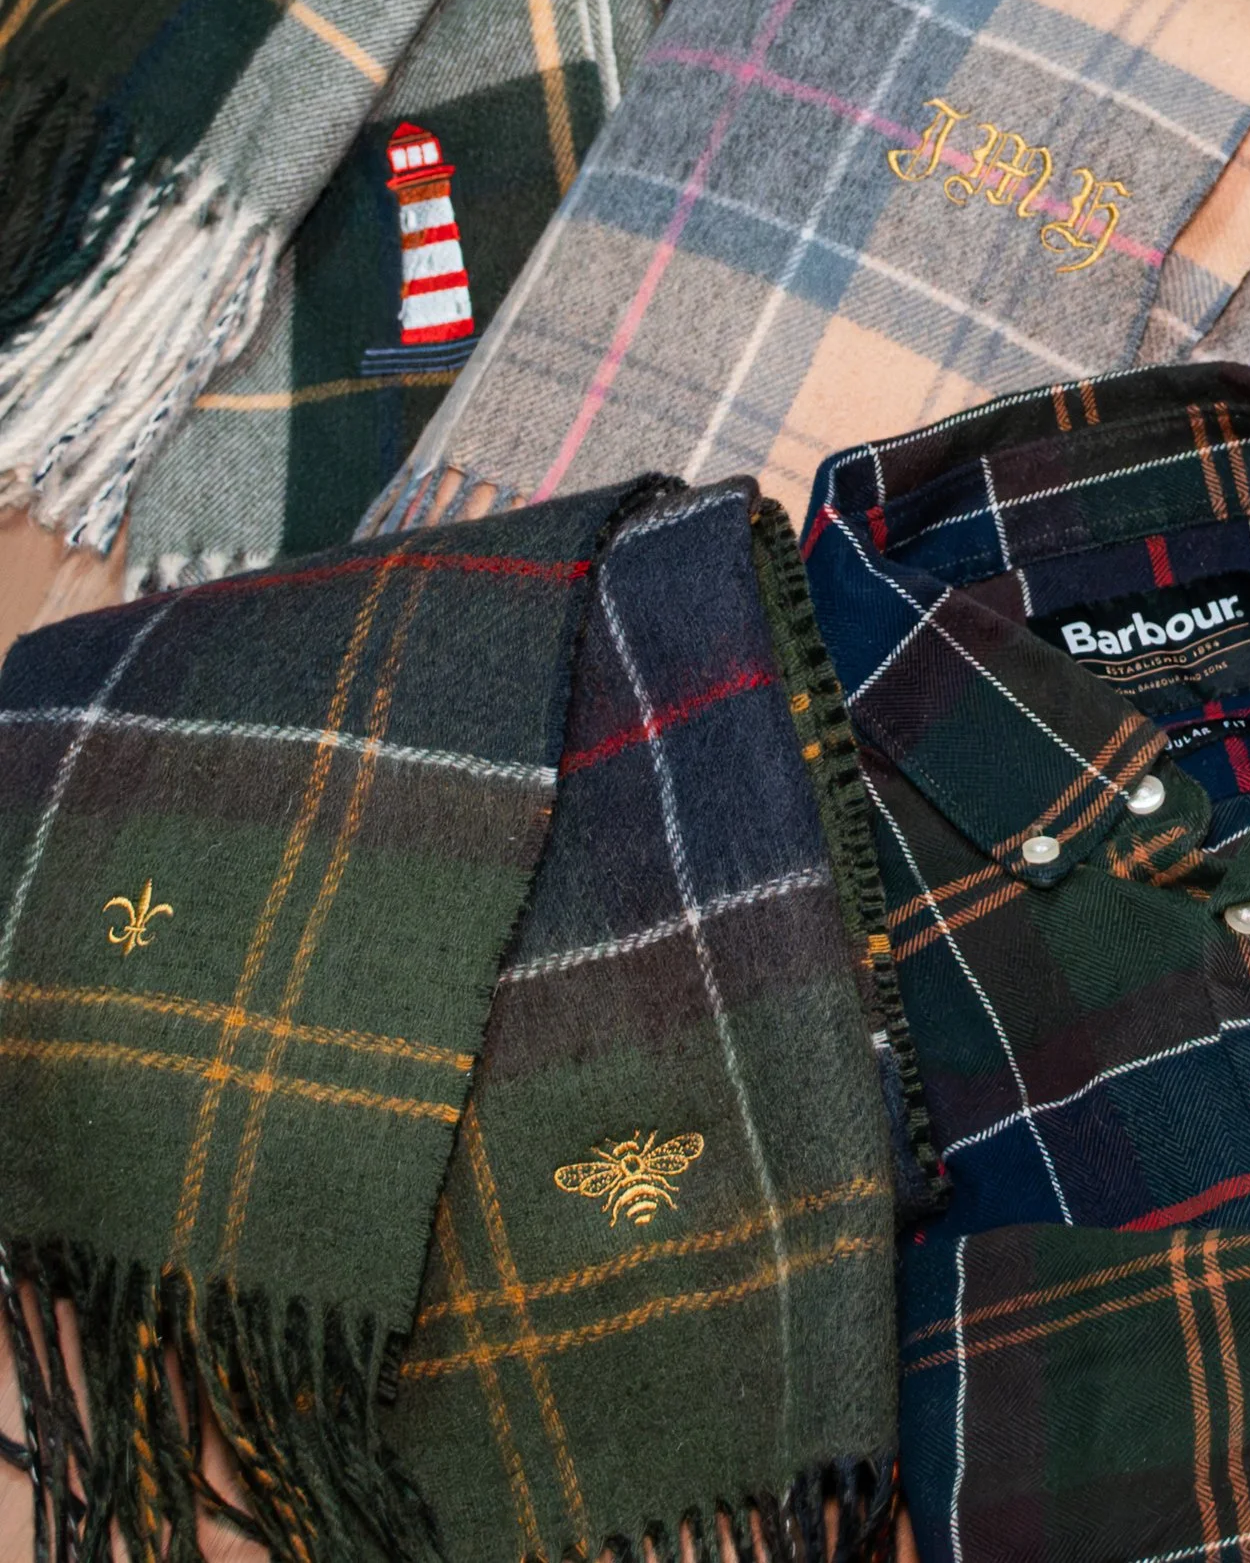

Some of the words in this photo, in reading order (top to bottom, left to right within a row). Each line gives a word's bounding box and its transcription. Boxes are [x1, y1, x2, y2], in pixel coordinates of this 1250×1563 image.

[1105, 654, 1188, 677] ESTABLISHED
[1137, 674, 1181, 693] BARBOUR
[1203, 660, 1229, 677] SONS
[1222, 719, 1246, 728] FIT
